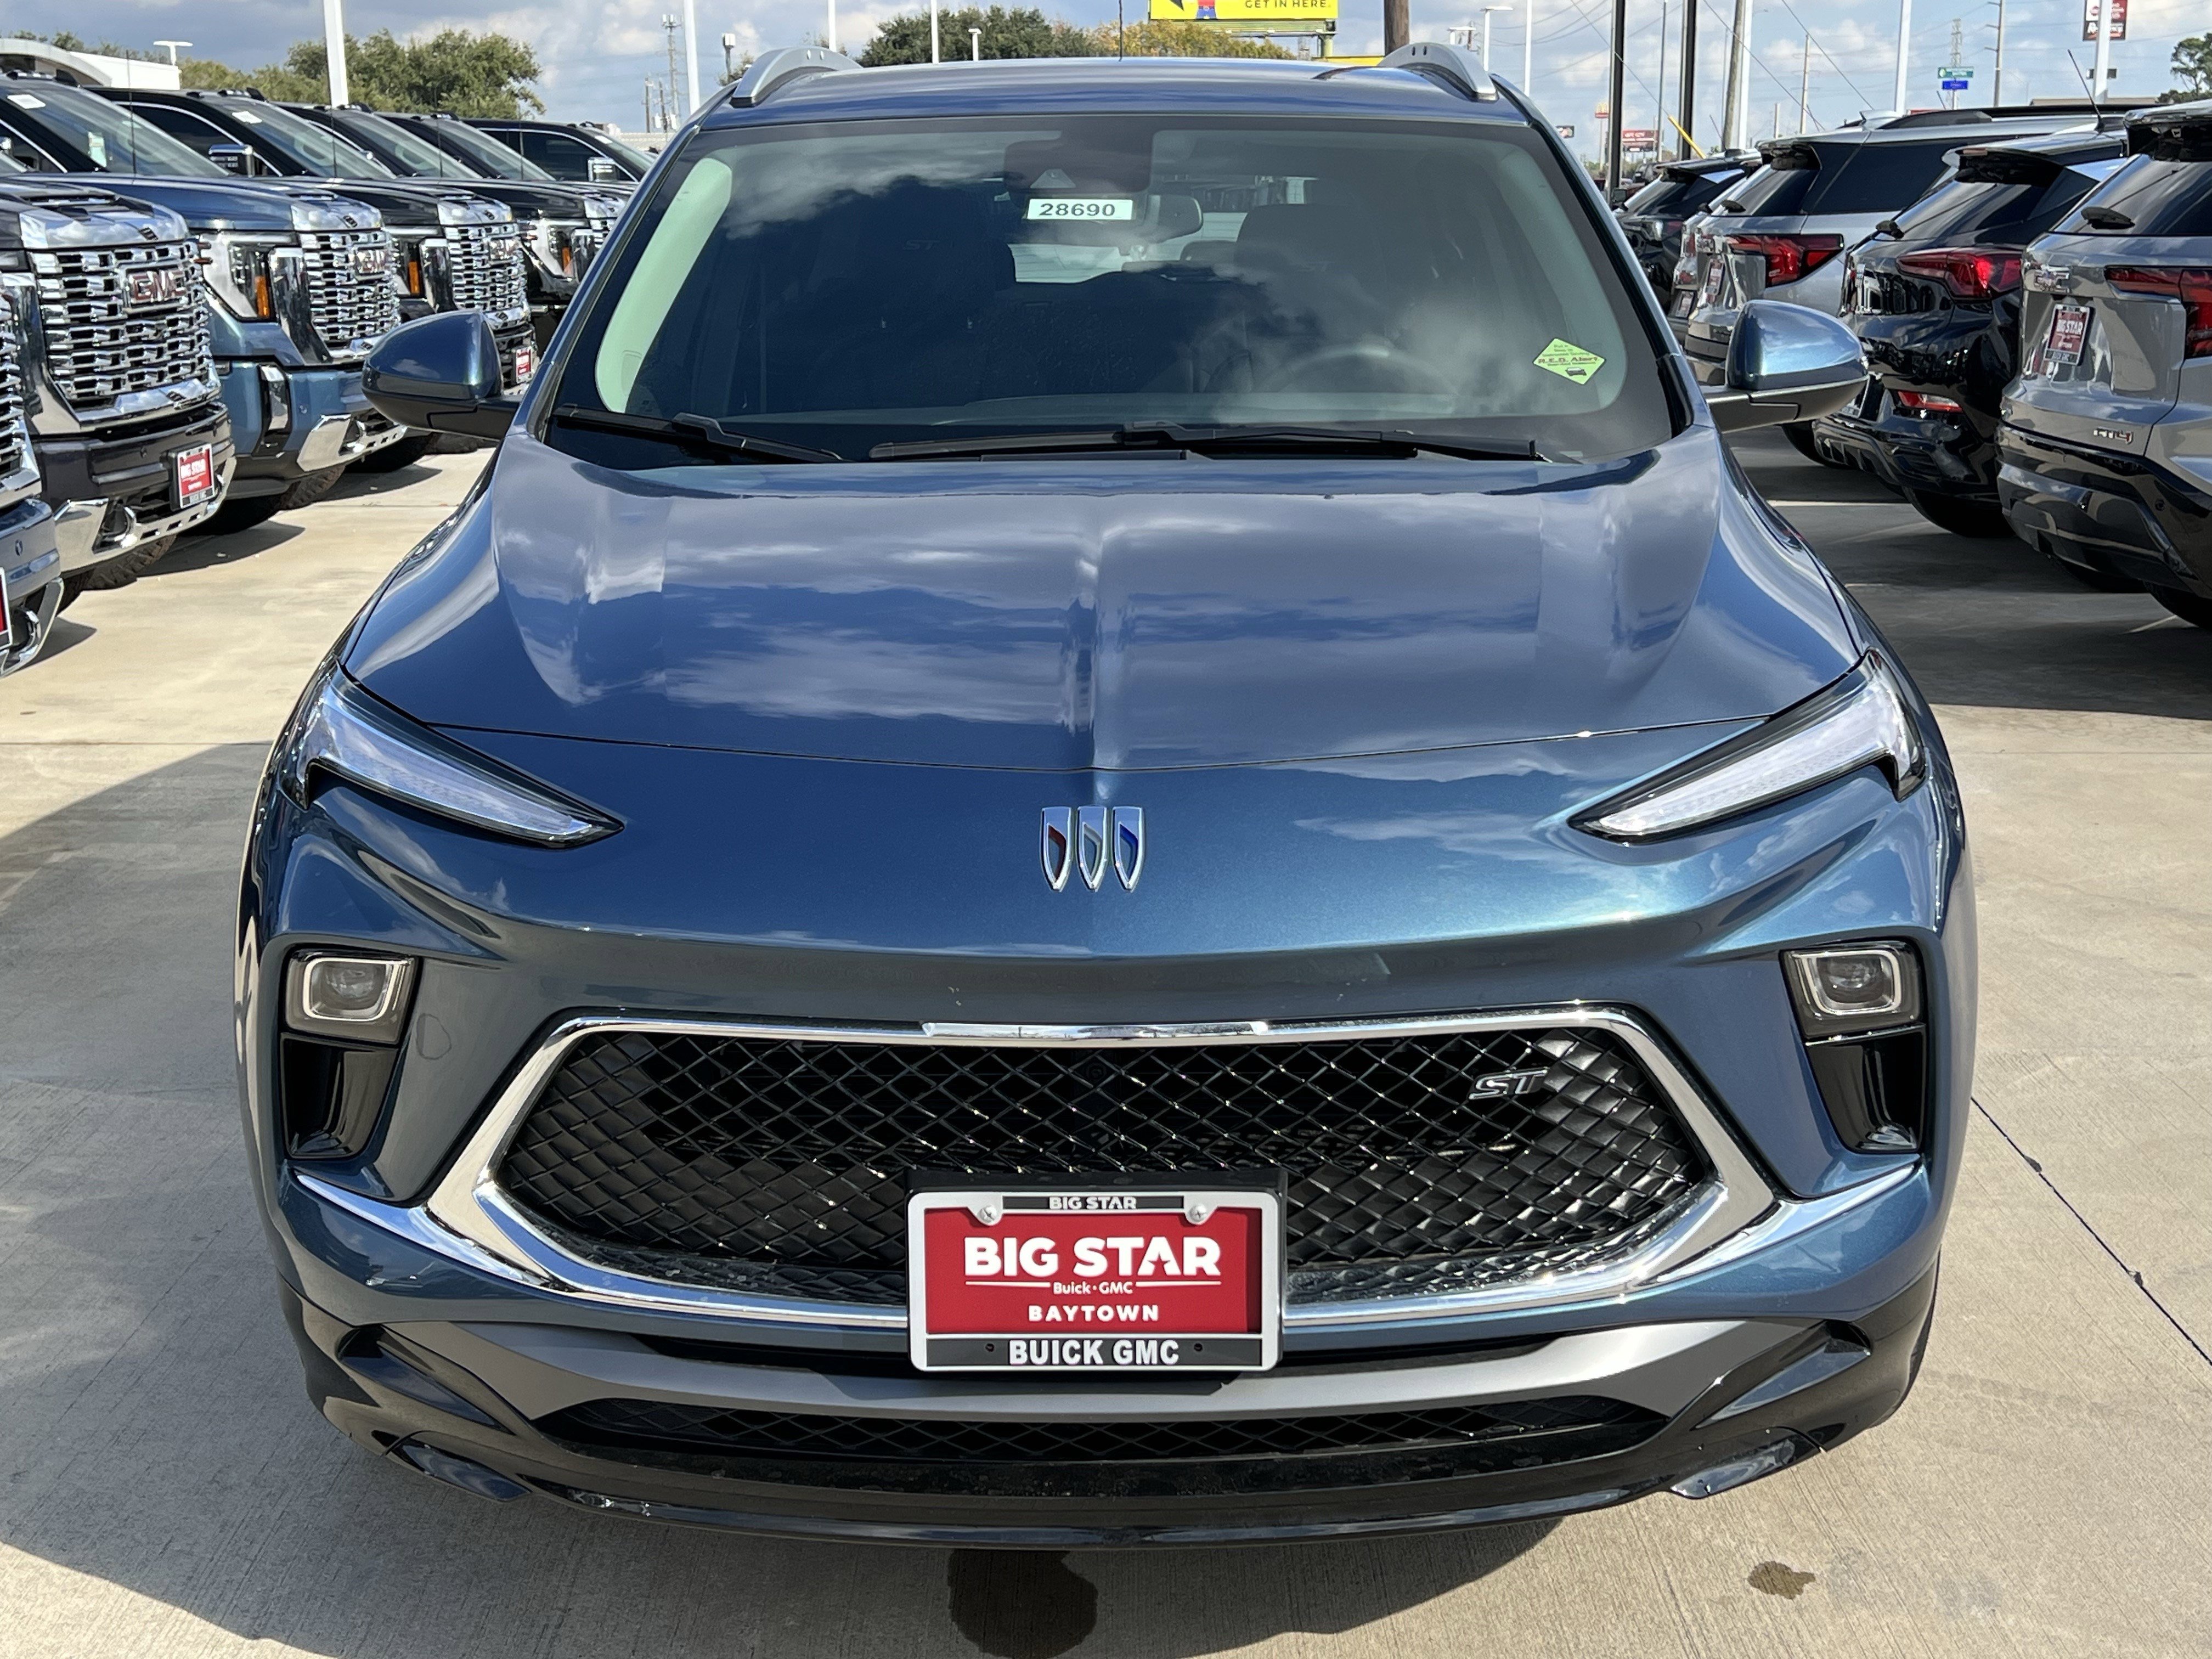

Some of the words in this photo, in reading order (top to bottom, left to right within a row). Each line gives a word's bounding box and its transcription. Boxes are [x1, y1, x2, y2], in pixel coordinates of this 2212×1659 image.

[1039, 204, 1115, 216] 28690
[1468, 1069, 1549, 1100] ST
[1049, 1197, 1082, 1210] BIG
[1086, 1197, 1137, 1209] STAR
[964, 1237, 1059, 1277] BIG
[1073, 1237, 1221, 1277] STAR
[1053, 1281, 1091, 1294] Buick
[1099, 1282, 1133, 1294] GMC
[1028, 1305, 1159, 1322] BAYTOWN
[1009, 1340, 1104, 1365] BUICK
[1113, 1340, 1178, 1365] GMC
